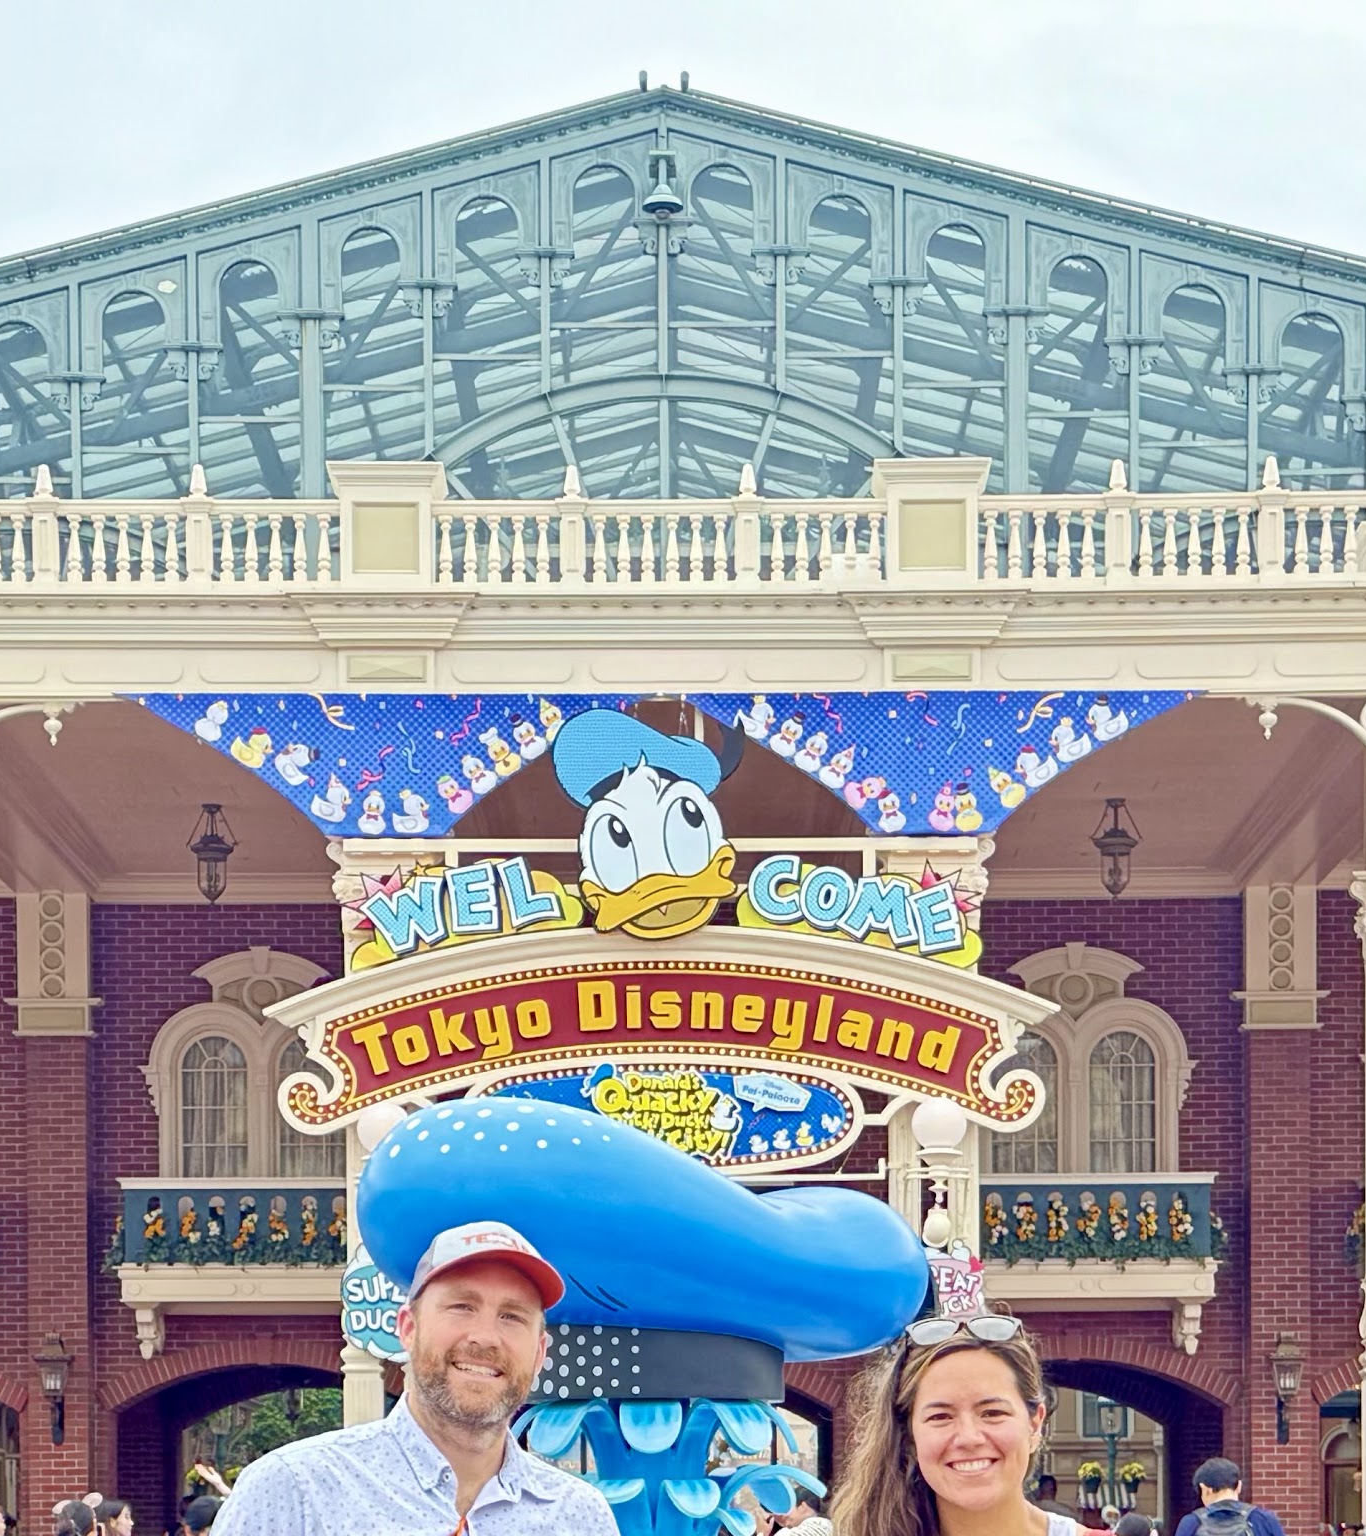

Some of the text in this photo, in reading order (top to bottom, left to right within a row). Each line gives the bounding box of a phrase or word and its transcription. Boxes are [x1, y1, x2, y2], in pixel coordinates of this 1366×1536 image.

[351, 980, 962, 1076] Tokyo Disneyland
[625, 1072, 701, 1092] Donald's
[595, 1078, 718, 1114] Quacky
[660, 1112, 710, 1129] Duck!
[349, 1310, 400, 1335] DUC
